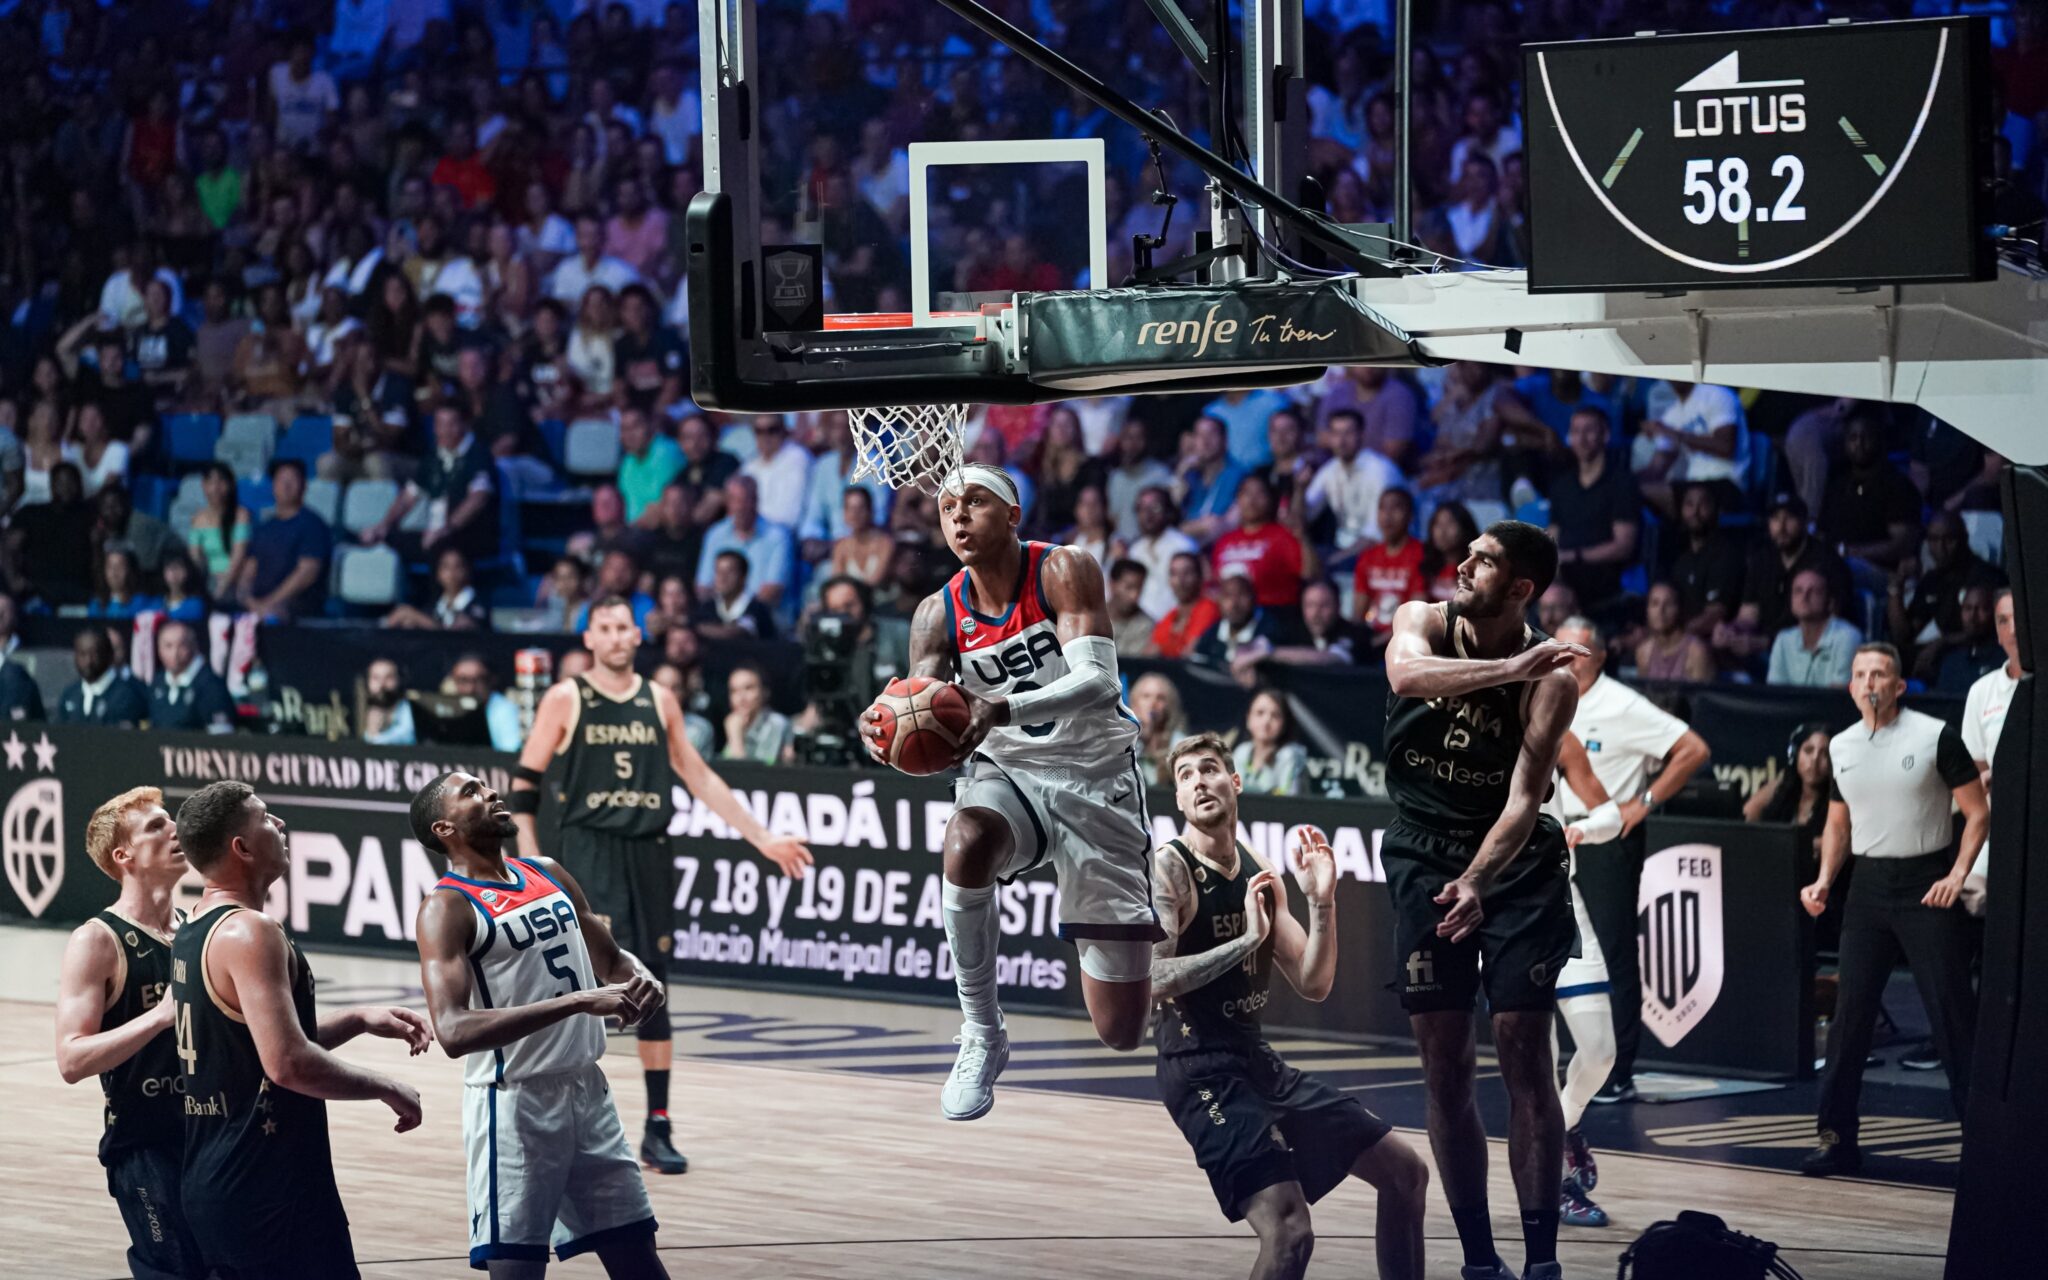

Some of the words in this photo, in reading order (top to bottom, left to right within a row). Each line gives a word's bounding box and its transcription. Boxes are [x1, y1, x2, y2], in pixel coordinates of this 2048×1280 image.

[1673, 93, 1807, 138] LOTUS
[1682, 154, 1807, 225] 58.2
[1137, 304, 1238, 358] renfe
[1249, 314, 1276, 344] Tu
[1279, 317, 1336, 344] tren
[971, 630, 1063, 686] USA
[585, 720, 658, 746] ESPAÑA
[159, 745, 261, 783] TORNEO
[265, 752, 361, 789] CIUDAD
[364, 758, 401, 793] DE
[614, 751, 633, 779] 5
[1404, 748, 1505, 787] endesa
[1678, 856, 1713, 878] FEB
[710, 859, 759, 915] 18
[766, 875, 791, 929] y
[794, 864, 845, 921] 19
[853, 868, 911, 926] DE
[501, 900, 579, 951] USA
[542, 943, 582, 997] 5
[757, 928, 893, 981] Municipal
[894, 937, 933, 978] de
